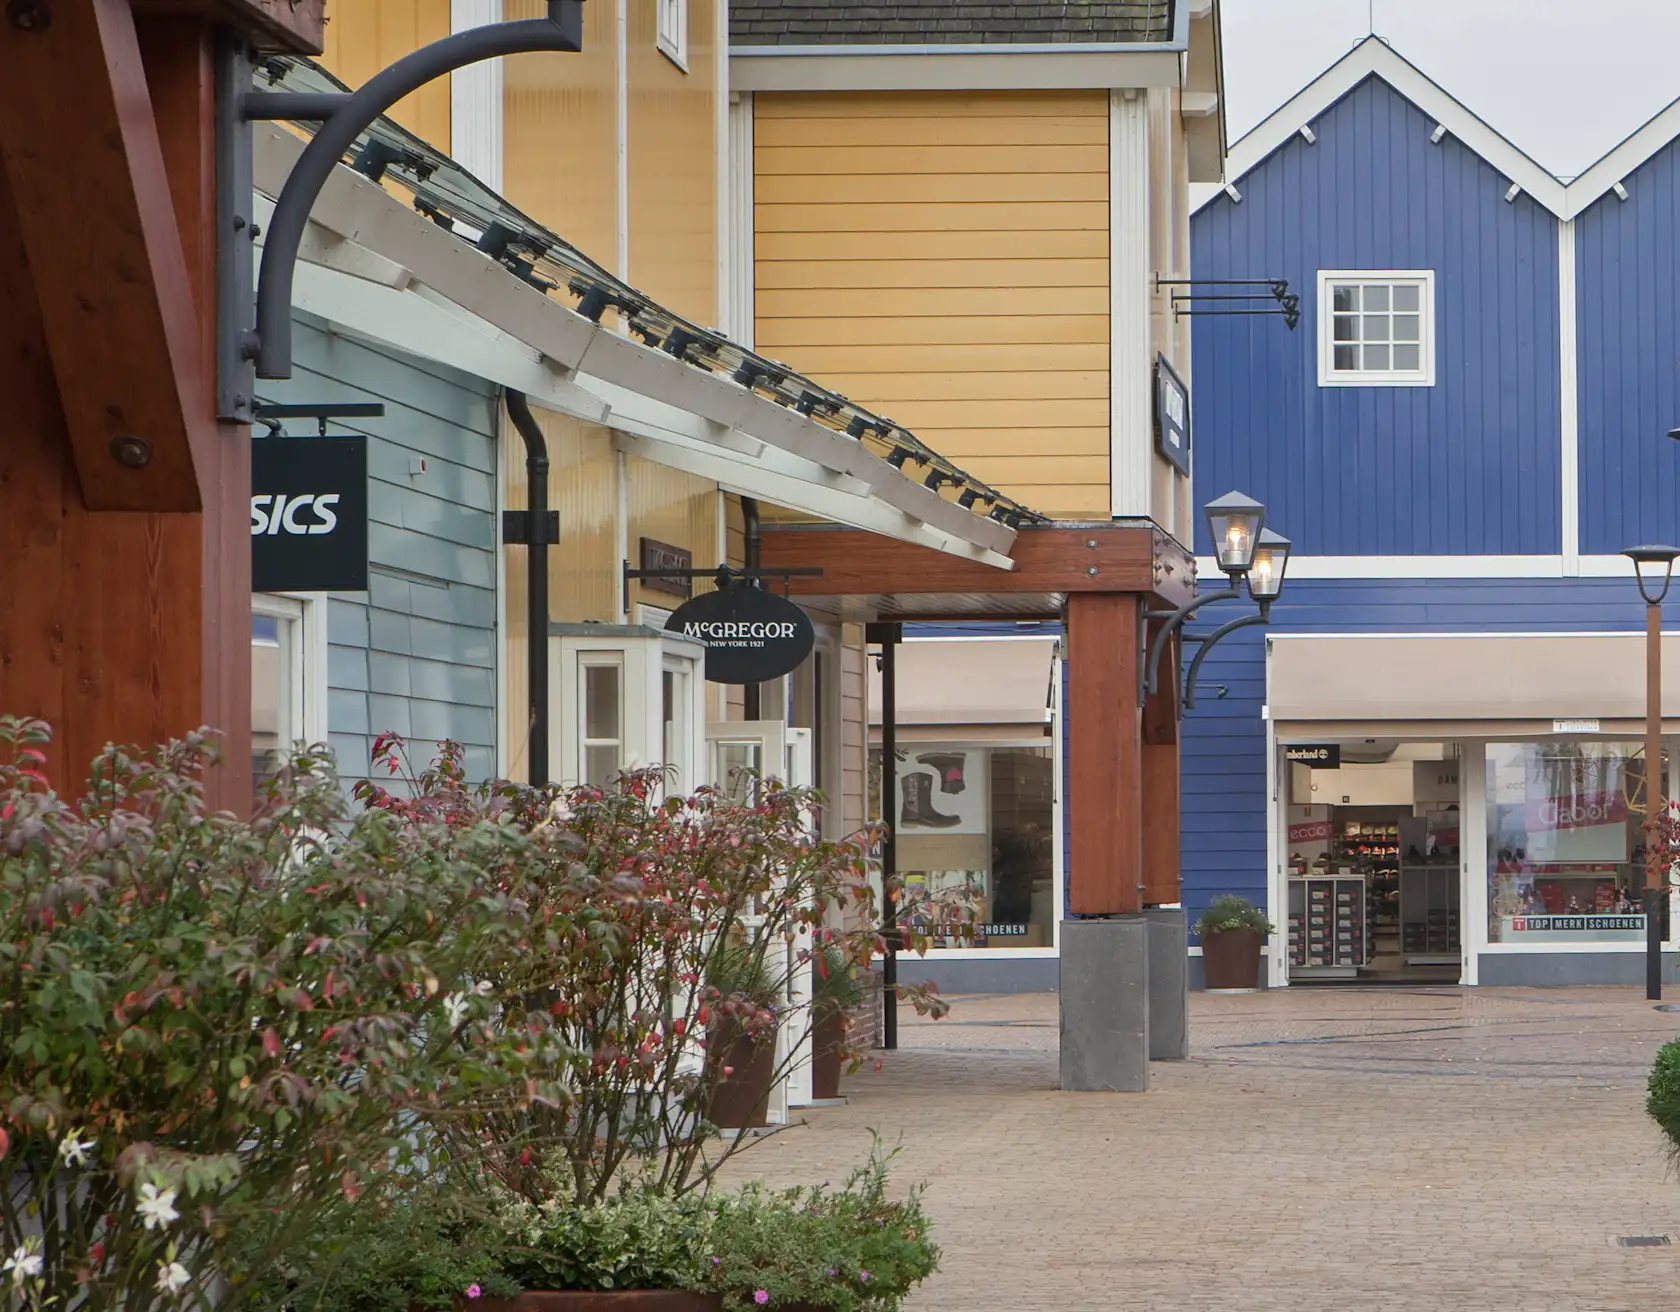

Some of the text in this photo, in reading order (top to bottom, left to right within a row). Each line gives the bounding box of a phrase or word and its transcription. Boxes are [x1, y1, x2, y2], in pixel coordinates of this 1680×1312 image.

[251, 494, 339, 534] SICS
[1290, 826, 1326, 839] ecco
[1529, 920, 1548, 929] TOP
[1555, 920, 1582, 929] MERK
[1589, 919, 1642, 929] SCHOENEN
